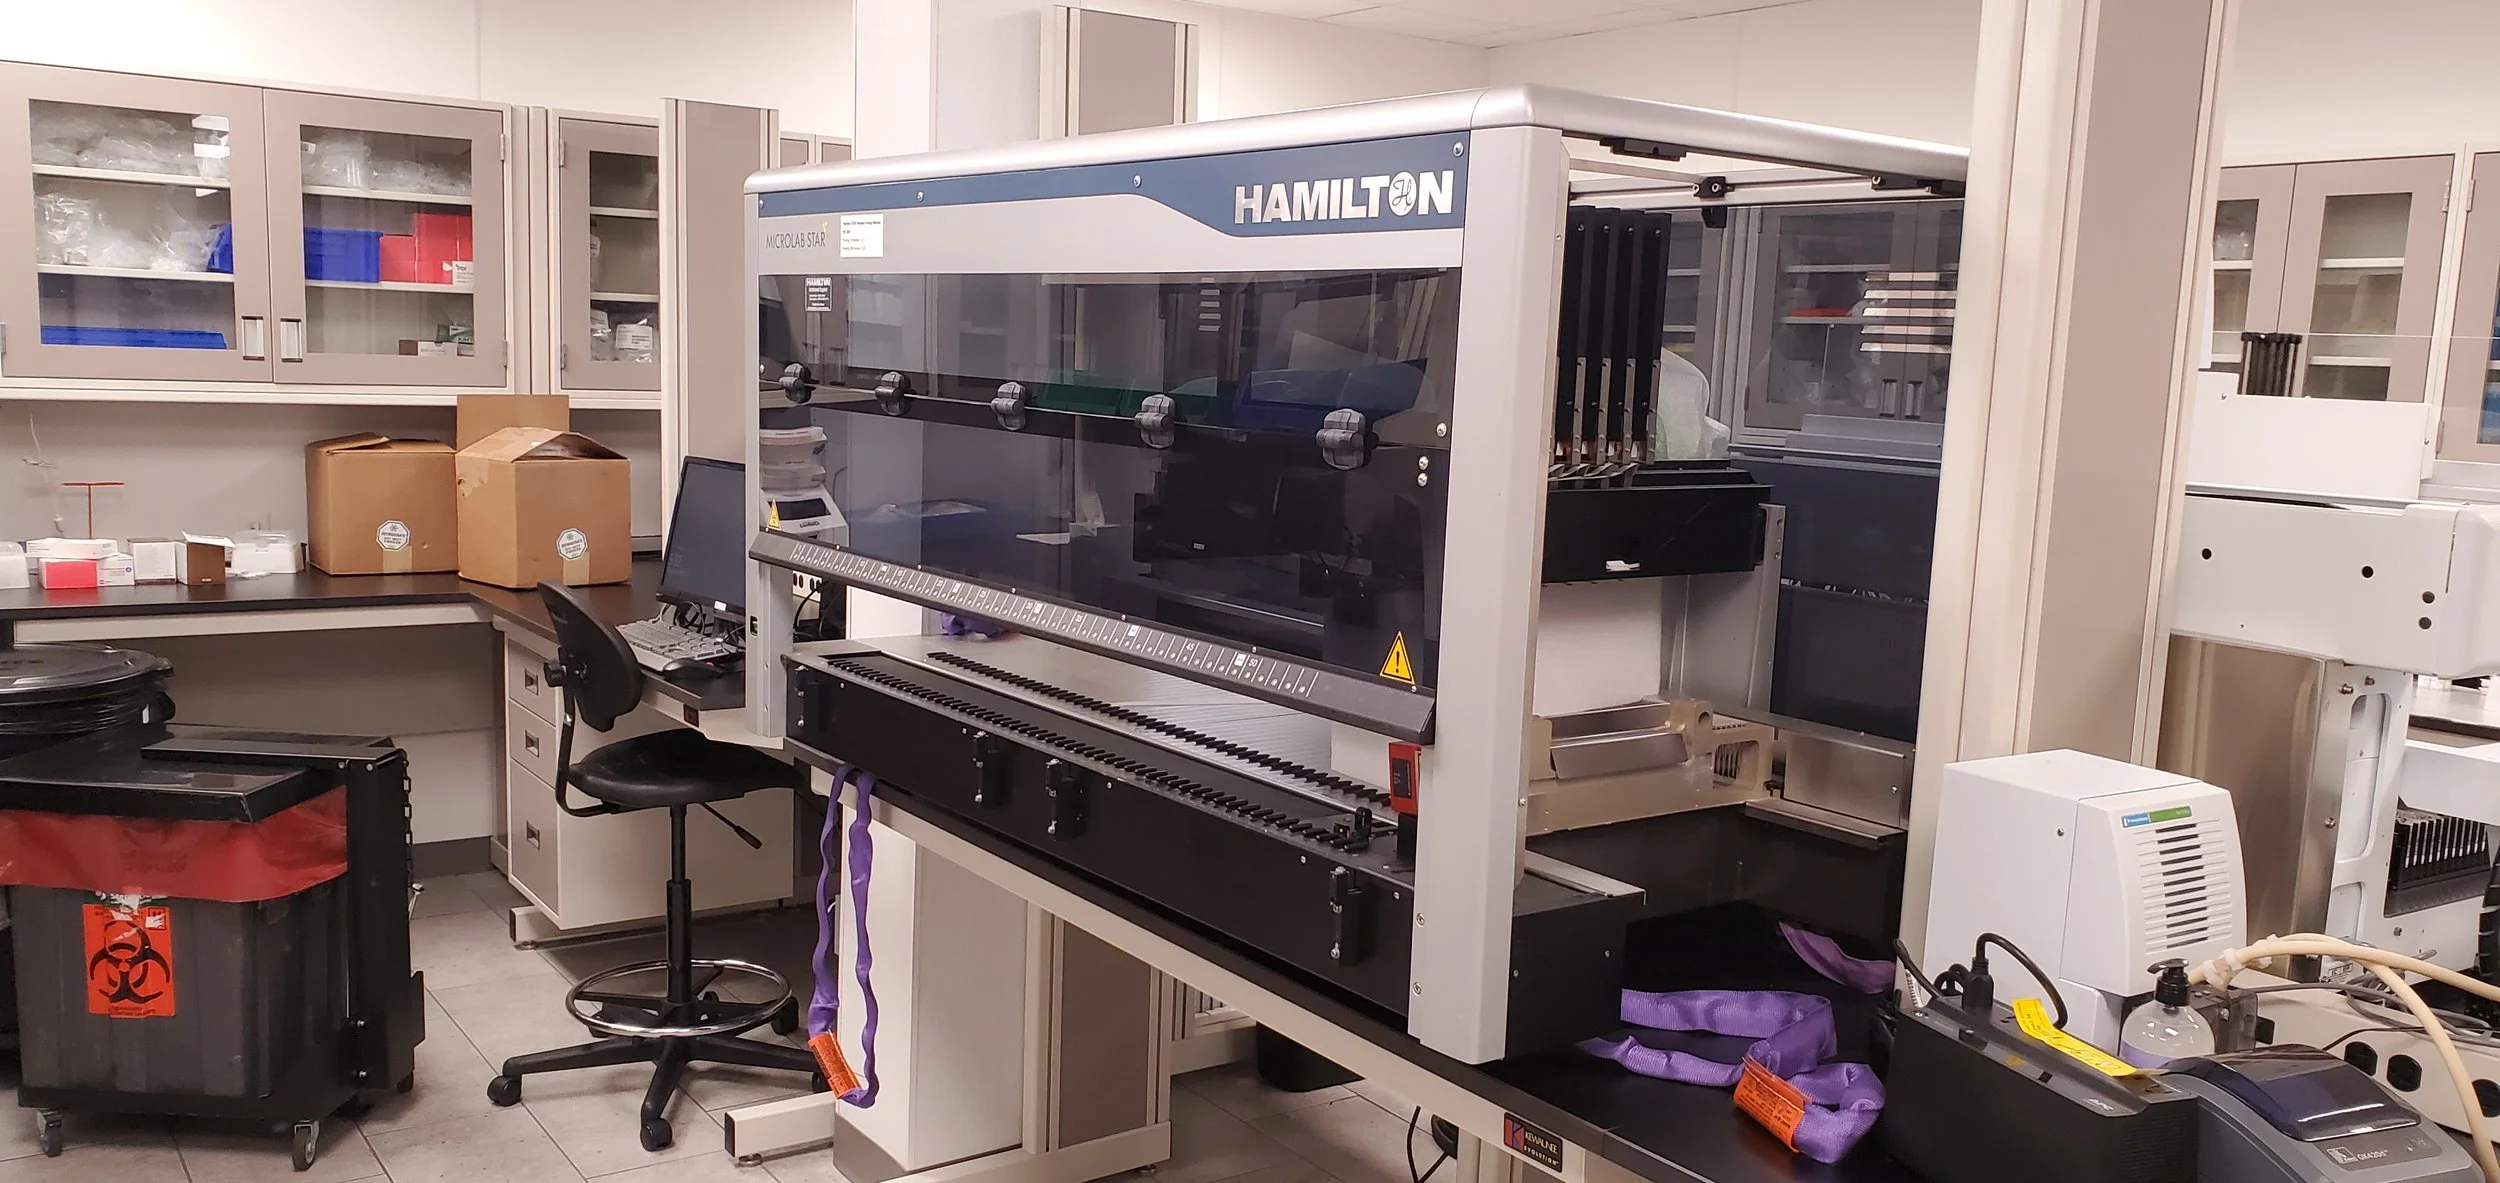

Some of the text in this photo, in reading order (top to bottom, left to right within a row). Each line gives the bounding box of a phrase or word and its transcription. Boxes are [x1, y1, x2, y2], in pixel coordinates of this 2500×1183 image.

[1234, 170, 1454, 224] HAMILTON
[766, 231, 826, 249] MICROLAB STAR
[1186, 643, 1196, 651] 45
[1248, 658, 1259, 668] 50
